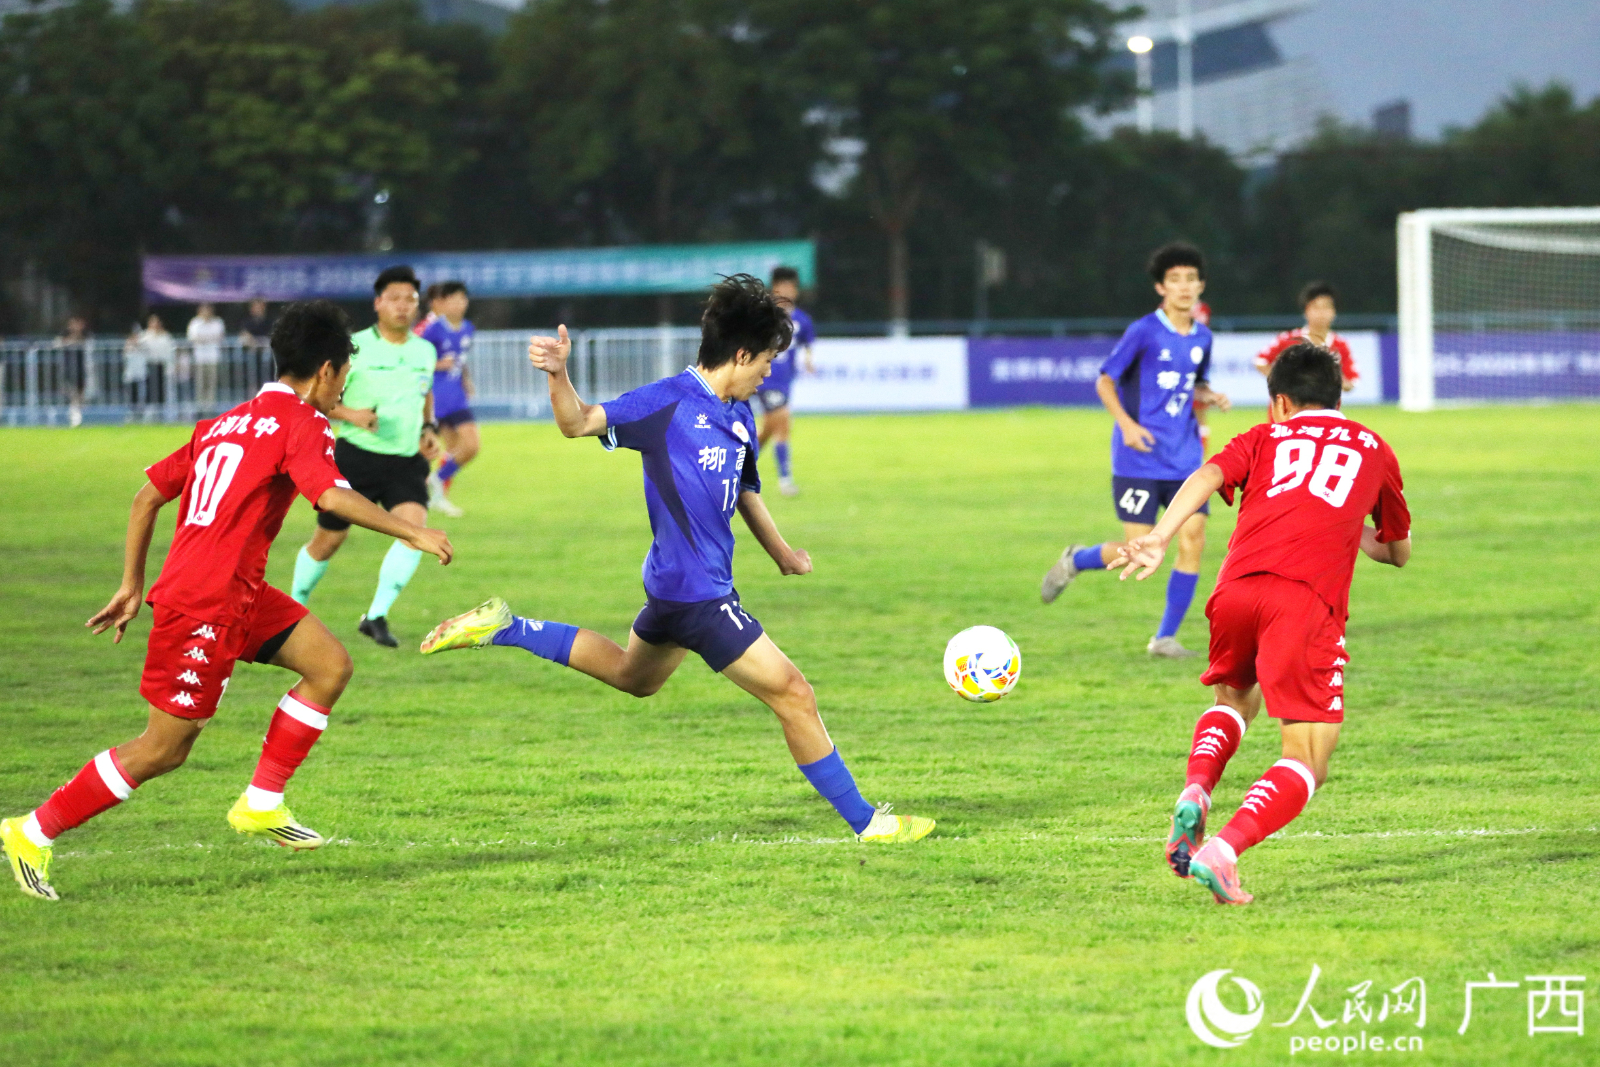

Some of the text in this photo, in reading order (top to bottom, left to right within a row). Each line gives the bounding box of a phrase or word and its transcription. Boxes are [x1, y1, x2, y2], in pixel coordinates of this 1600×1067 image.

[1269, 423, 1379, 450] 北海九中
[184, 441, 244, 527] 10
[1266, 438, 1363, 508] 98
[721, 476, 738, 512] 11
[1119, 487, 1150, 516] 47
